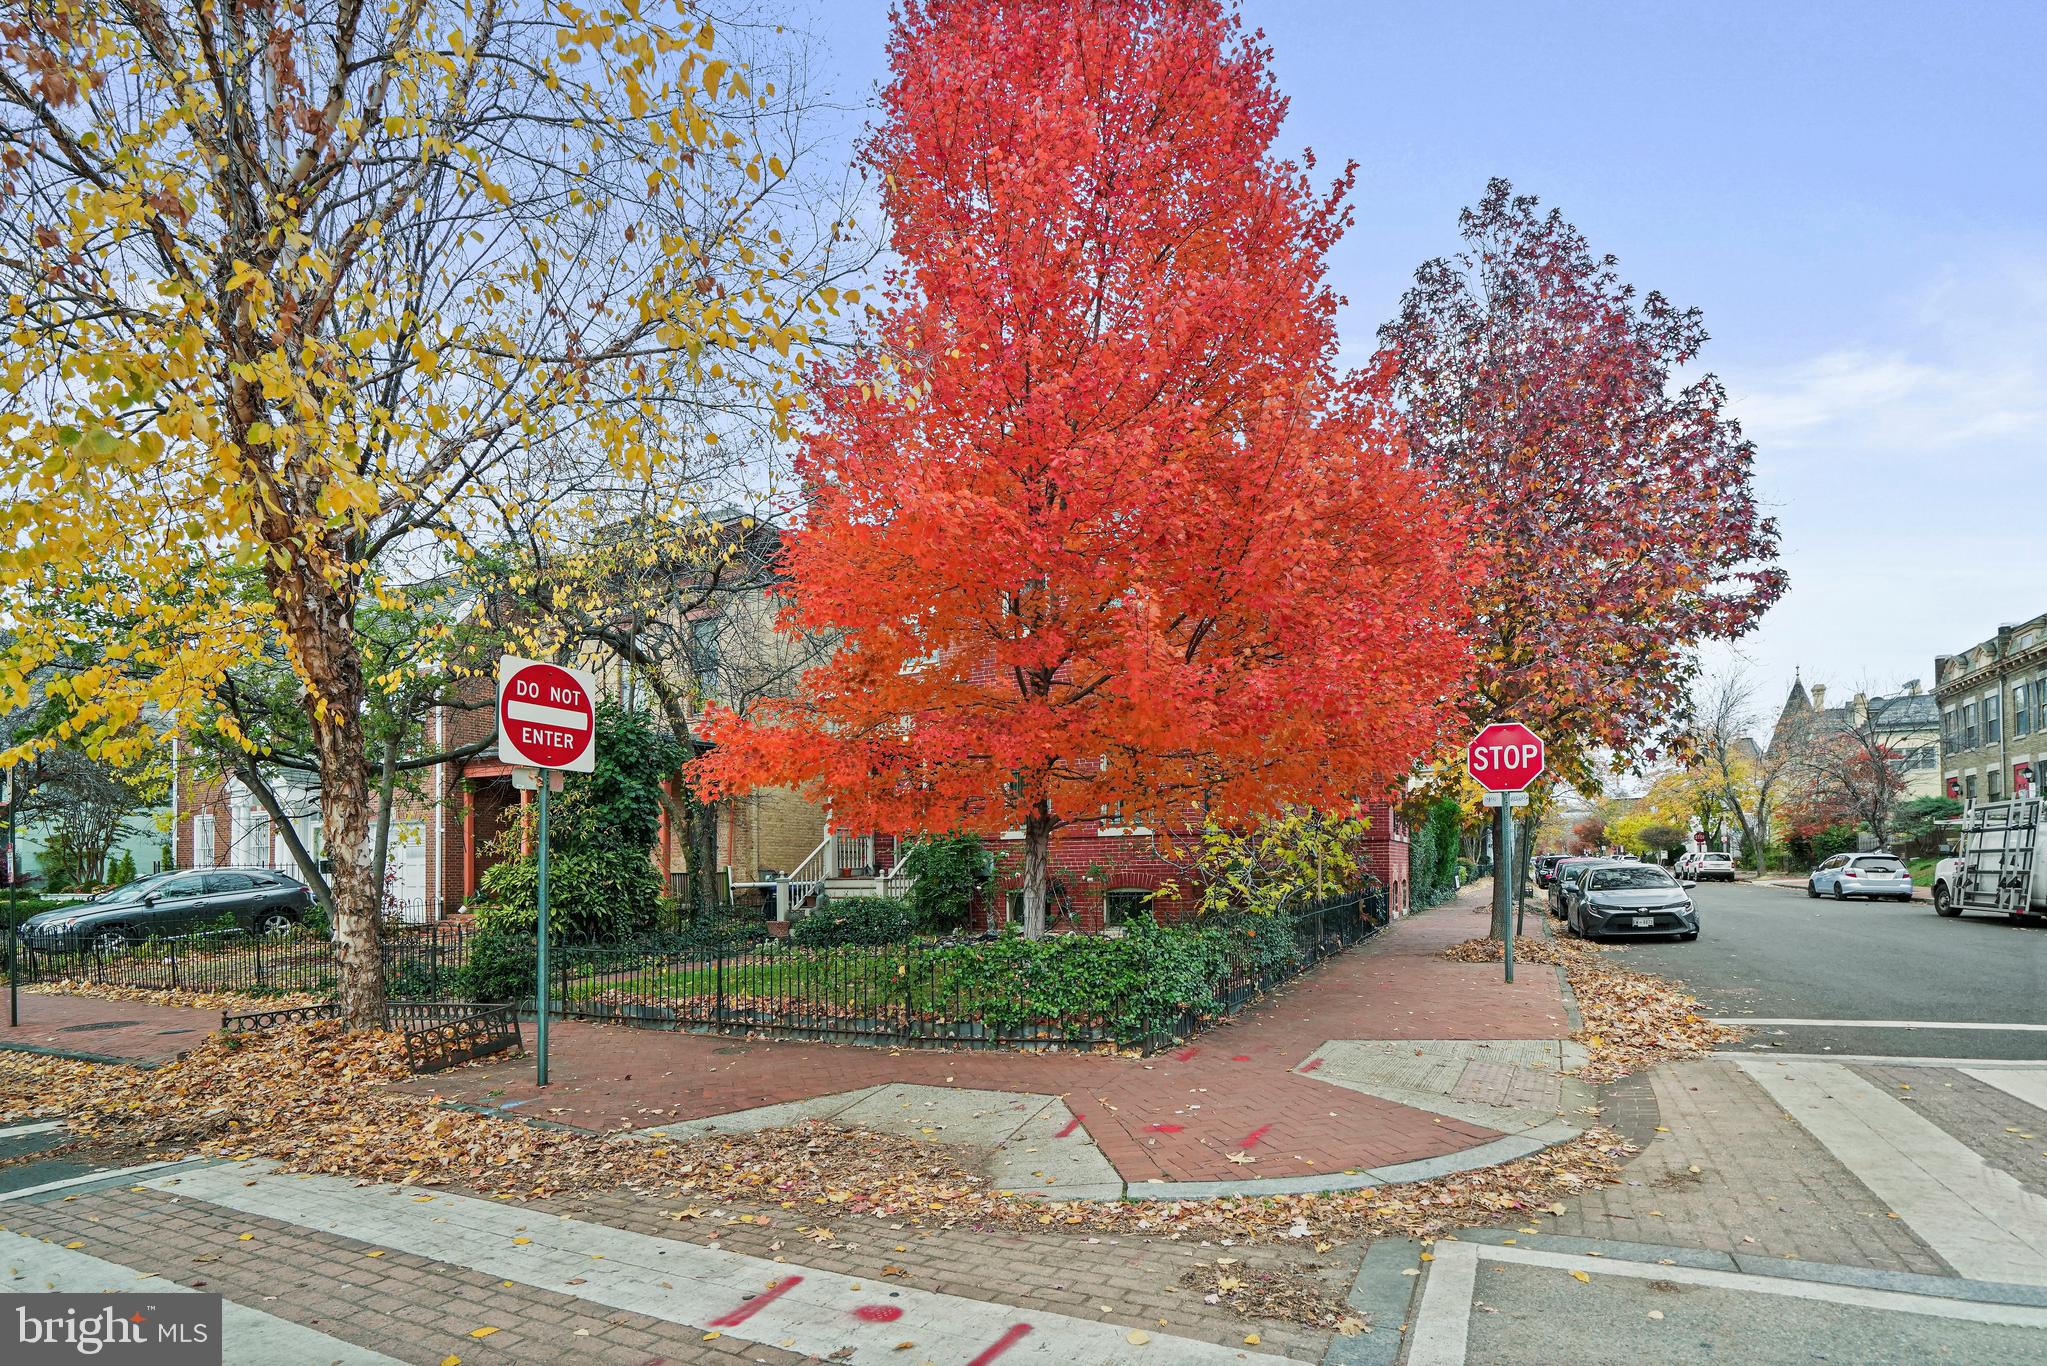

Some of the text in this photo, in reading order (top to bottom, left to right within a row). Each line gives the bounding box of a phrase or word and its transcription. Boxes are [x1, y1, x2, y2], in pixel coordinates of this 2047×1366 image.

[517, 680, 580, 706] DO NOT
[522, 727, 574, 749] ENTER
[1473, 744, 1538, 771] STOP
